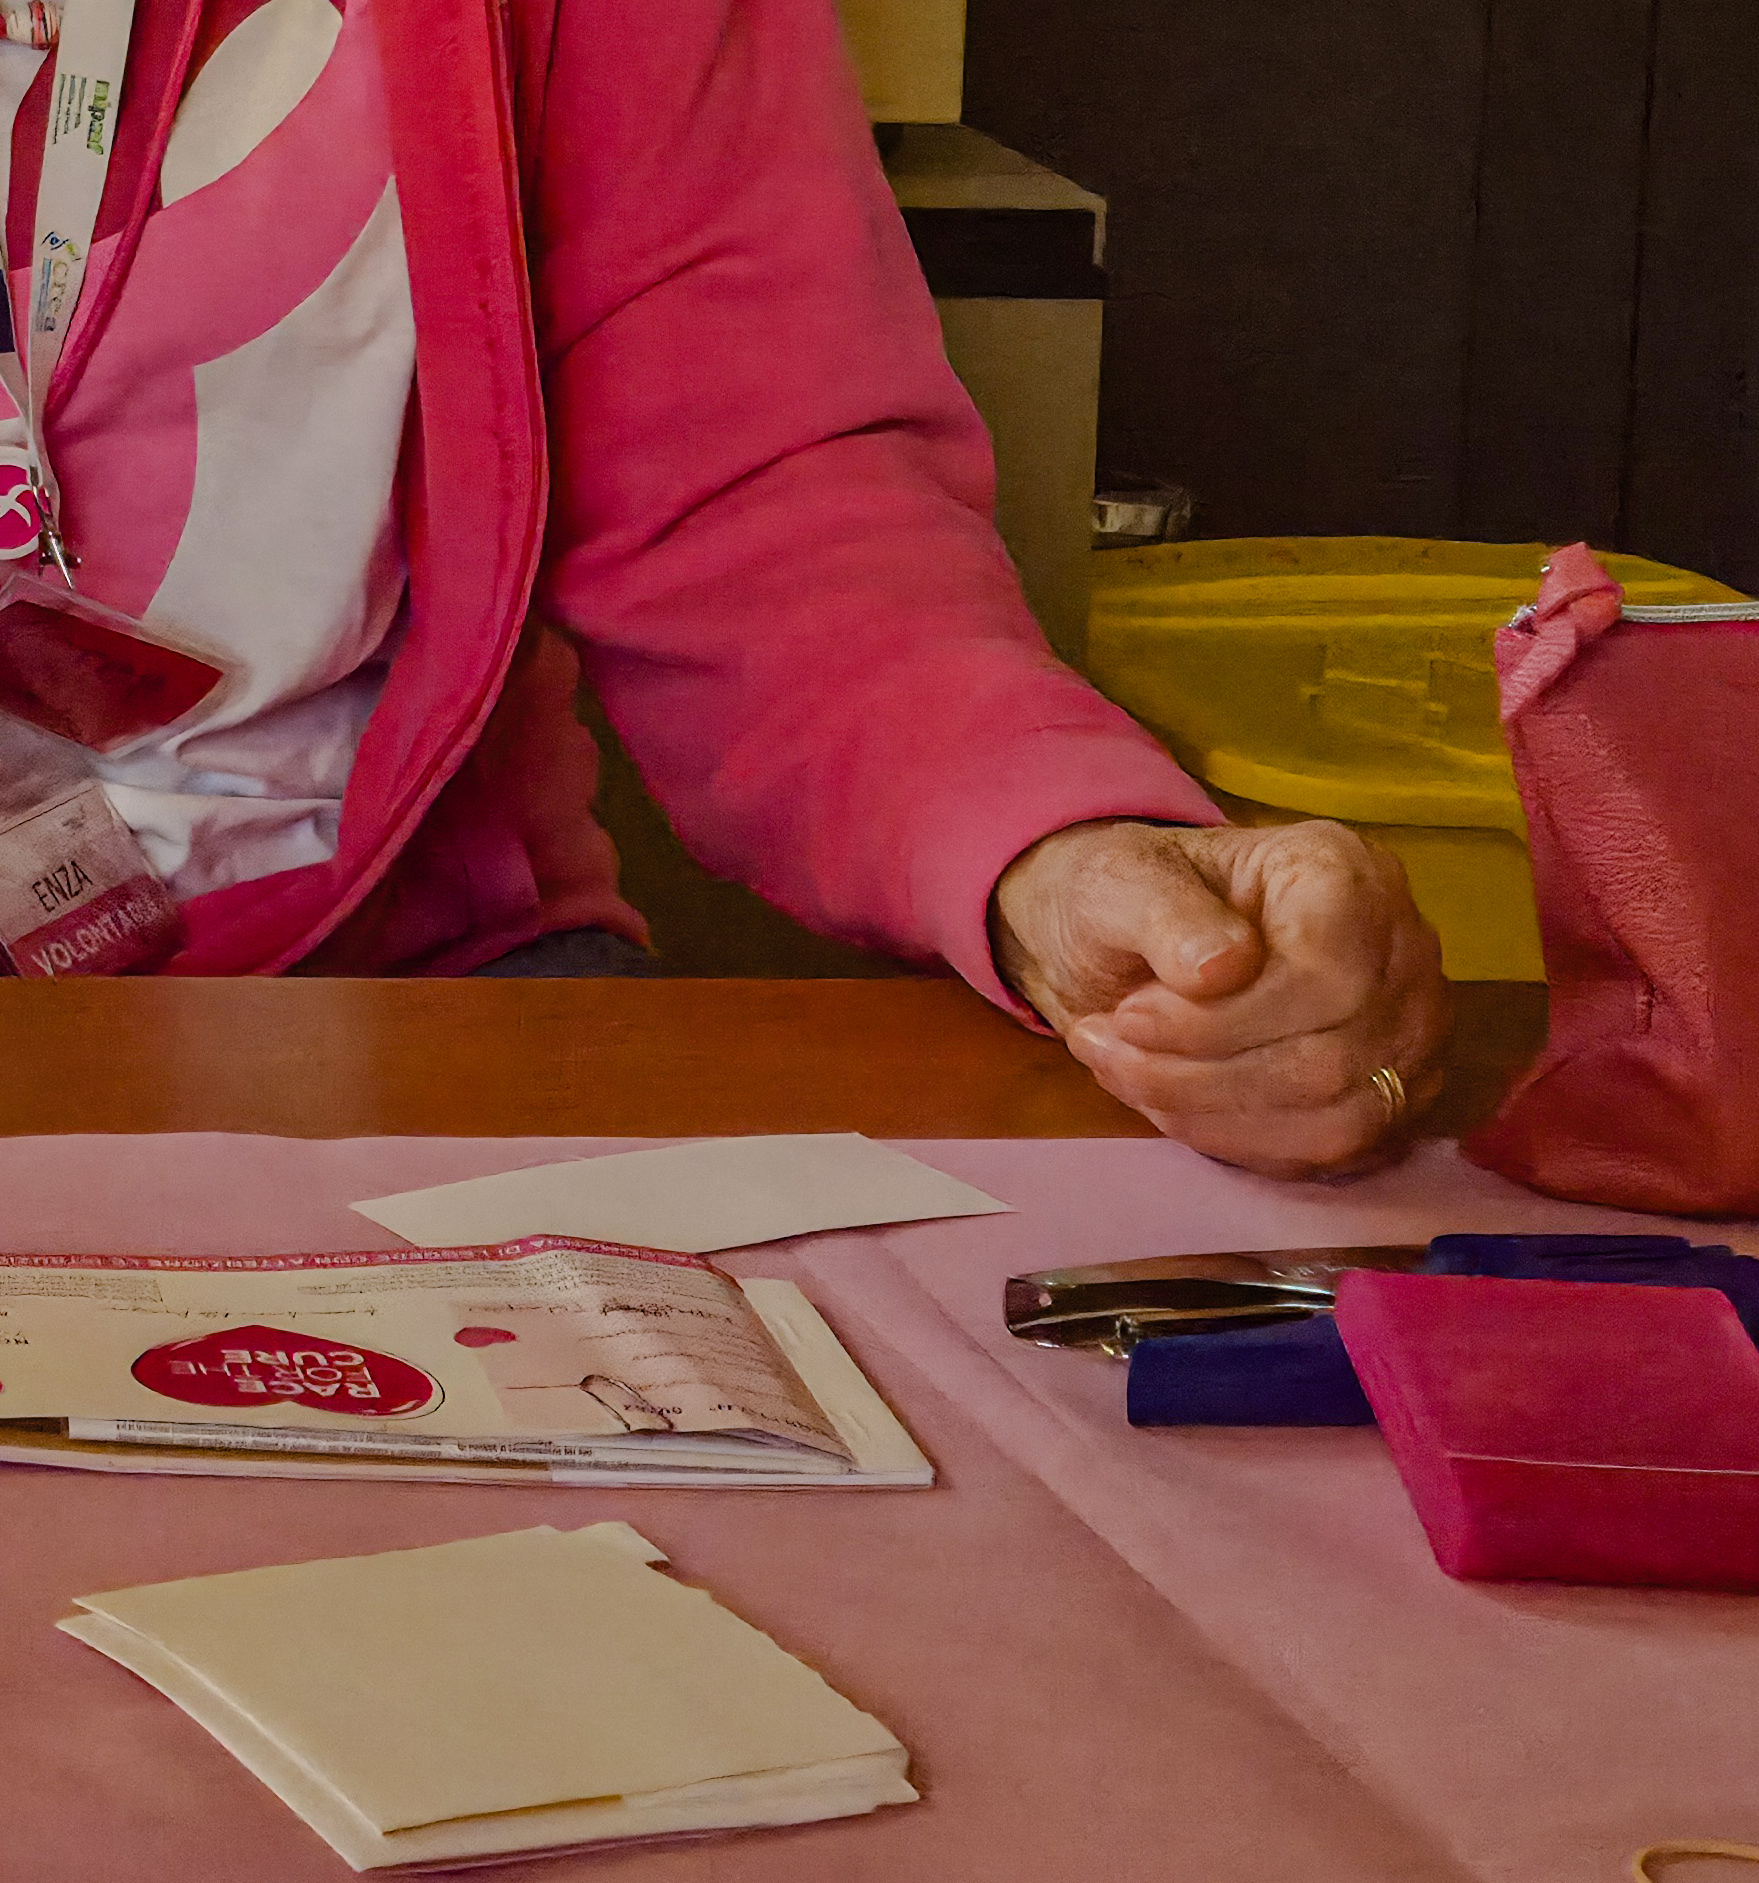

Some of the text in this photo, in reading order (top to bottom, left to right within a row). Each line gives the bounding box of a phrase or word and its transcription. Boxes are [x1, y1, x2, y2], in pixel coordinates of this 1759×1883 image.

[31, 859, 93, 912] ENZA
[221, 1350, 363, 1365] CURE
[169, 1361, 370, 1380] FOR THE
[234, 1379, 380, 1397] RACE
